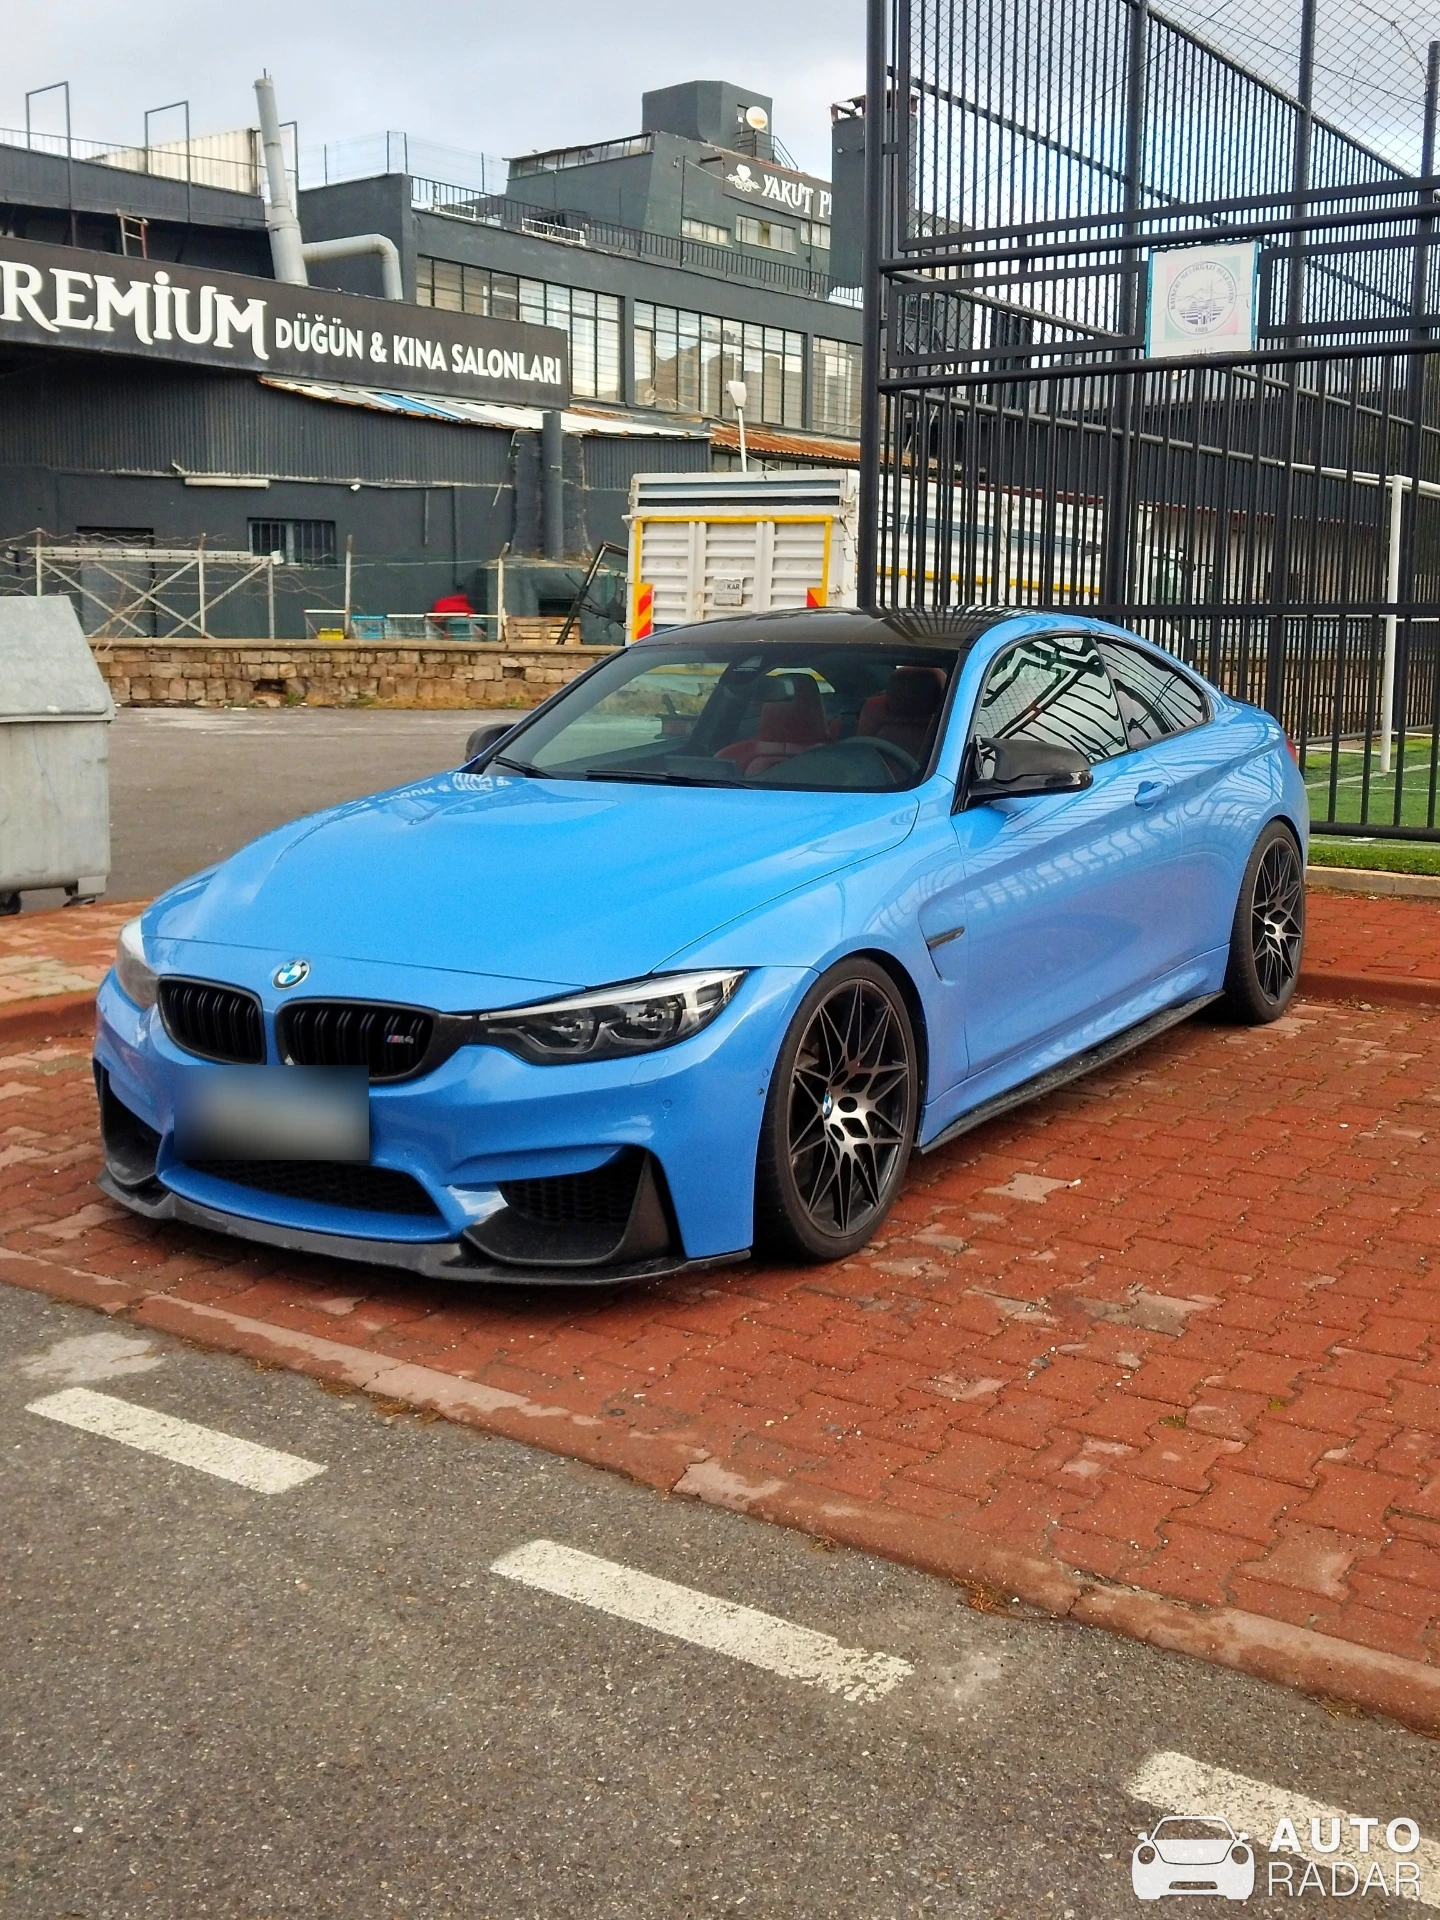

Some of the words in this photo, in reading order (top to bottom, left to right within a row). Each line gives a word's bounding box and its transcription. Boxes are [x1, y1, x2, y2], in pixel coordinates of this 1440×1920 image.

[761, 174, 814, 214] YAKUT
[275, 312, 363, 360] DÜĞÜN
[369, 331, 388, 363] &
[393, 334, 448, 372] KINA
[451, 343, 562, 385] SALONLARI
